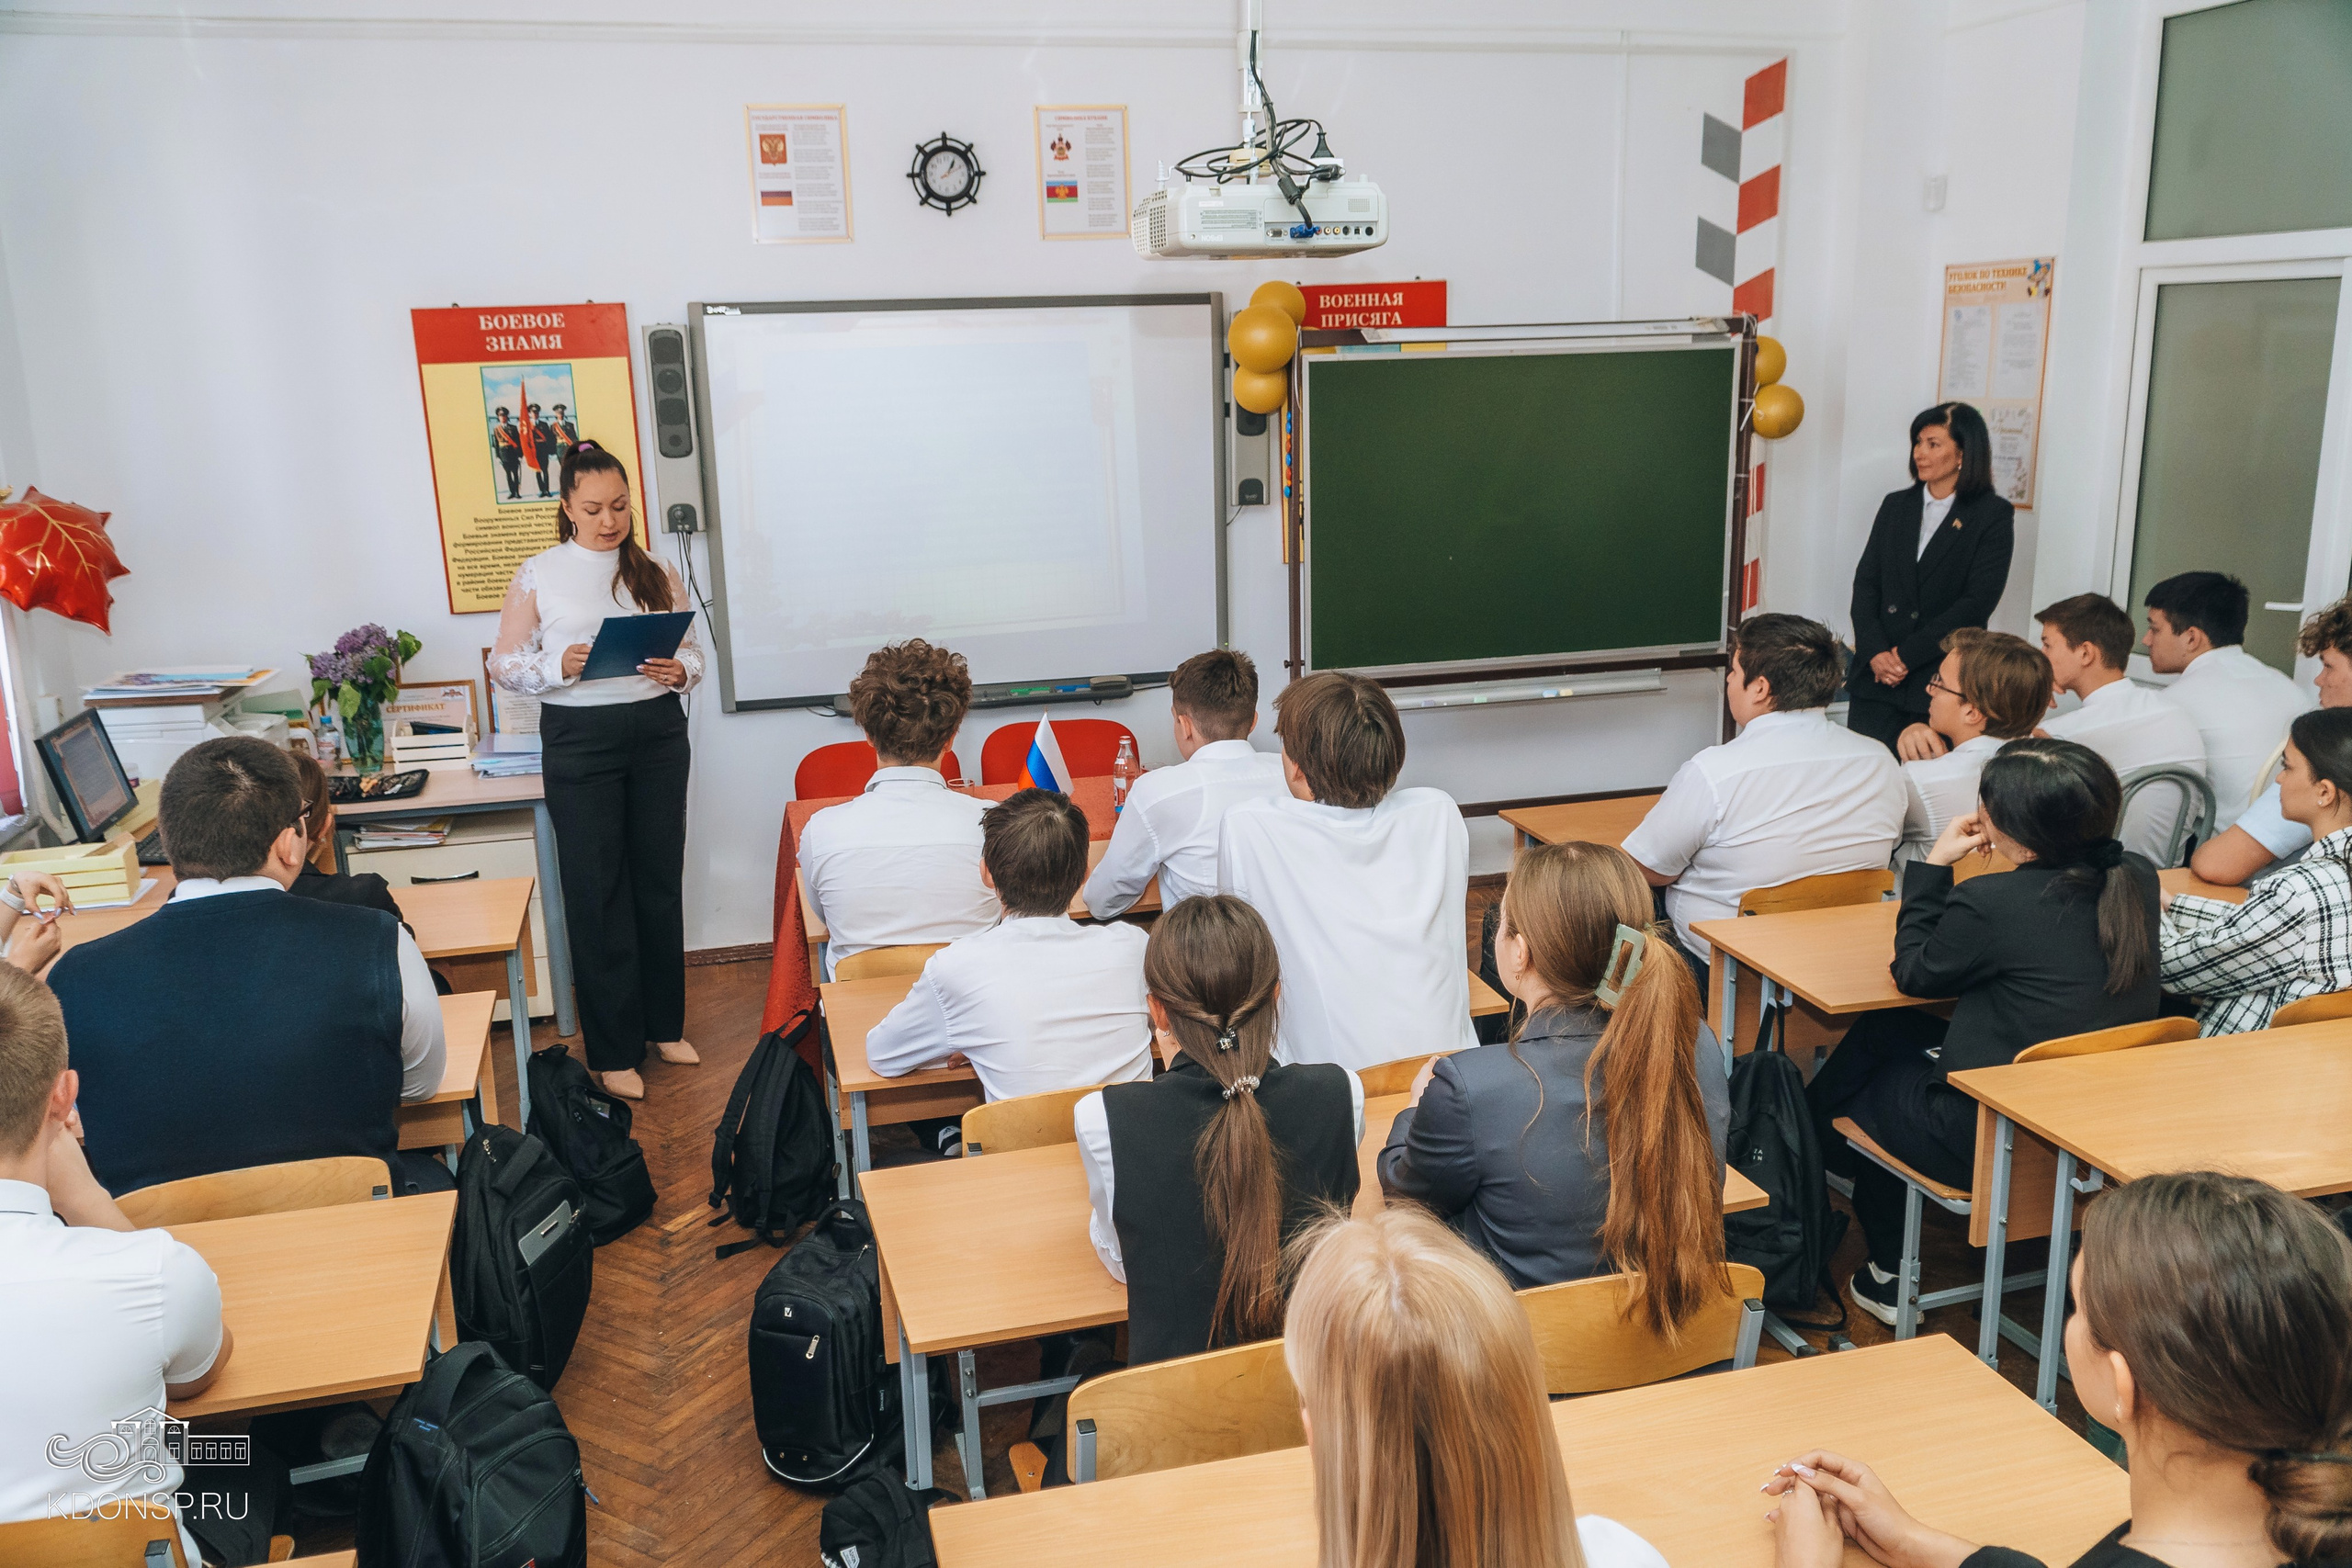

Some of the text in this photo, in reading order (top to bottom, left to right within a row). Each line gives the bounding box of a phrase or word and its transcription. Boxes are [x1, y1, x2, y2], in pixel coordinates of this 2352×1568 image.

[1949, 266, 2027, 281] УГОЛОК ПО ТЕХНИКЕ
[1948, 281, 2006, 294] БЕЗОПАСНОСТИ
[1319, 292, 1404, 309] ВОЕННАЯ
[479, 312, 565, 331] БОЕВОЕ
[1321, 311, 1403, 327] ПРИСЯГА
[485, 333, 564, 353] ЗНАМЯ
[386, 703, 446, 714] СЕРТИФИКАТ
